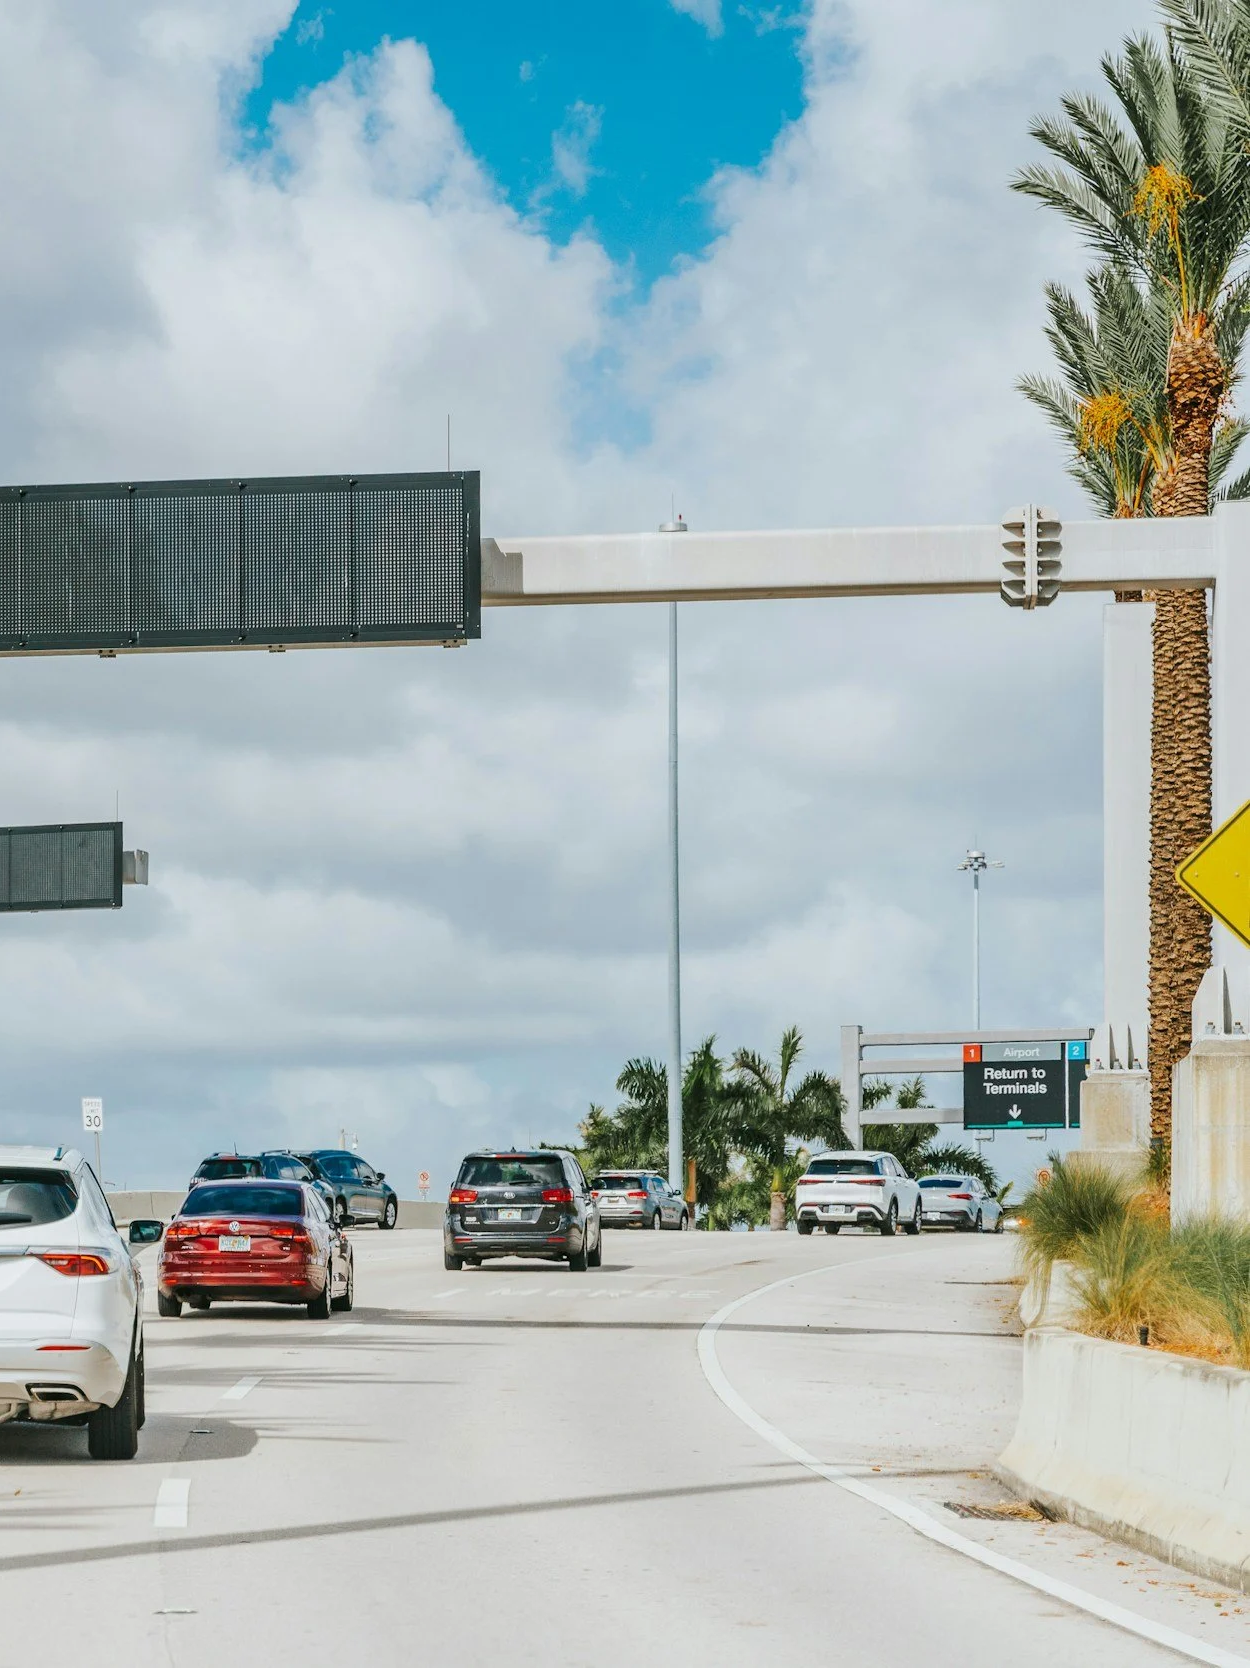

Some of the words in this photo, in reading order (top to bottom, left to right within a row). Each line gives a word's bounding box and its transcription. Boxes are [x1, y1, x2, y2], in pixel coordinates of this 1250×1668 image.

[969, 1048, 975, 1058] 1
[1003, 1047, 1040, 1058] Airport
[1072, 1045, 1080, 1056] 2
[984, 1067, 1028, 1080] Return
[1031, 1067, 1046, 1079] to
[983, 1081, 1048, 1095] Terminals
[85, 1115, 101, 1127] 30
